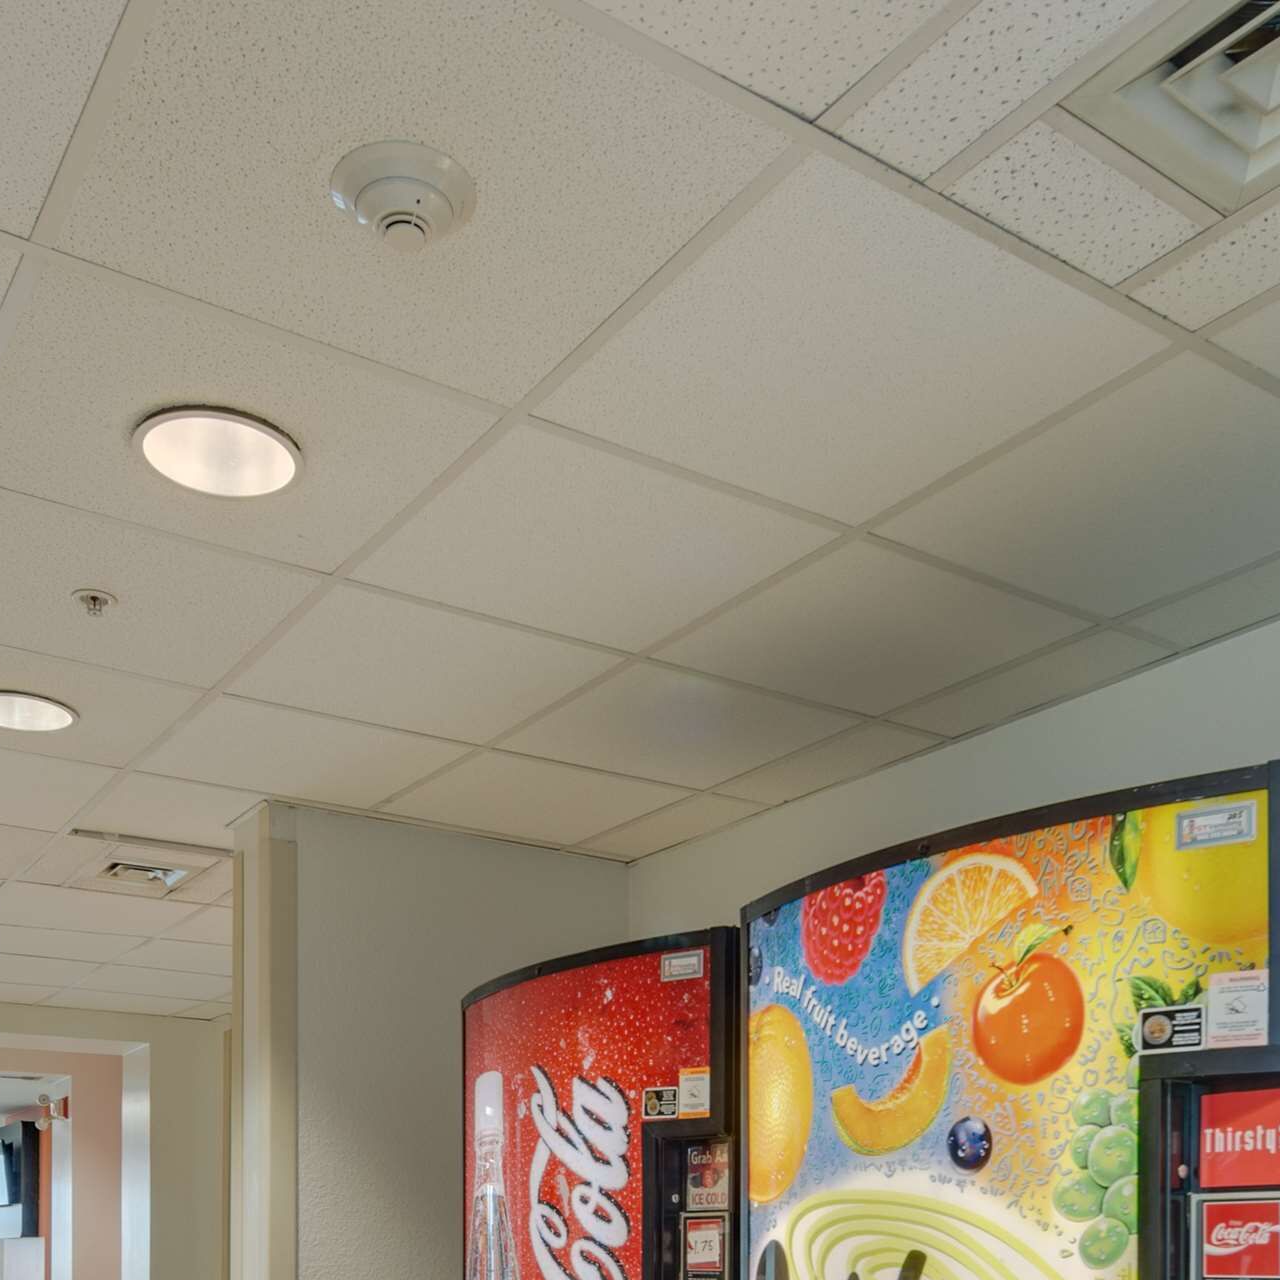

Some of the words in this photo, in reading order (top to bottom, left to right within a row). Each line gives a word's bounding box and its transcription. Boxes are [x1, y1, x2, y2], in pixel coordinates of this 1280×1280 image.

[772, 967, 805, 1003] Real
[803, 982, 837, 1039] fruit
[835, 1010, 928, 1067] beverage
[690, 1150, 712, 1165] Grab
[1211, 1219, 1272, 1248] Coca-Cola
